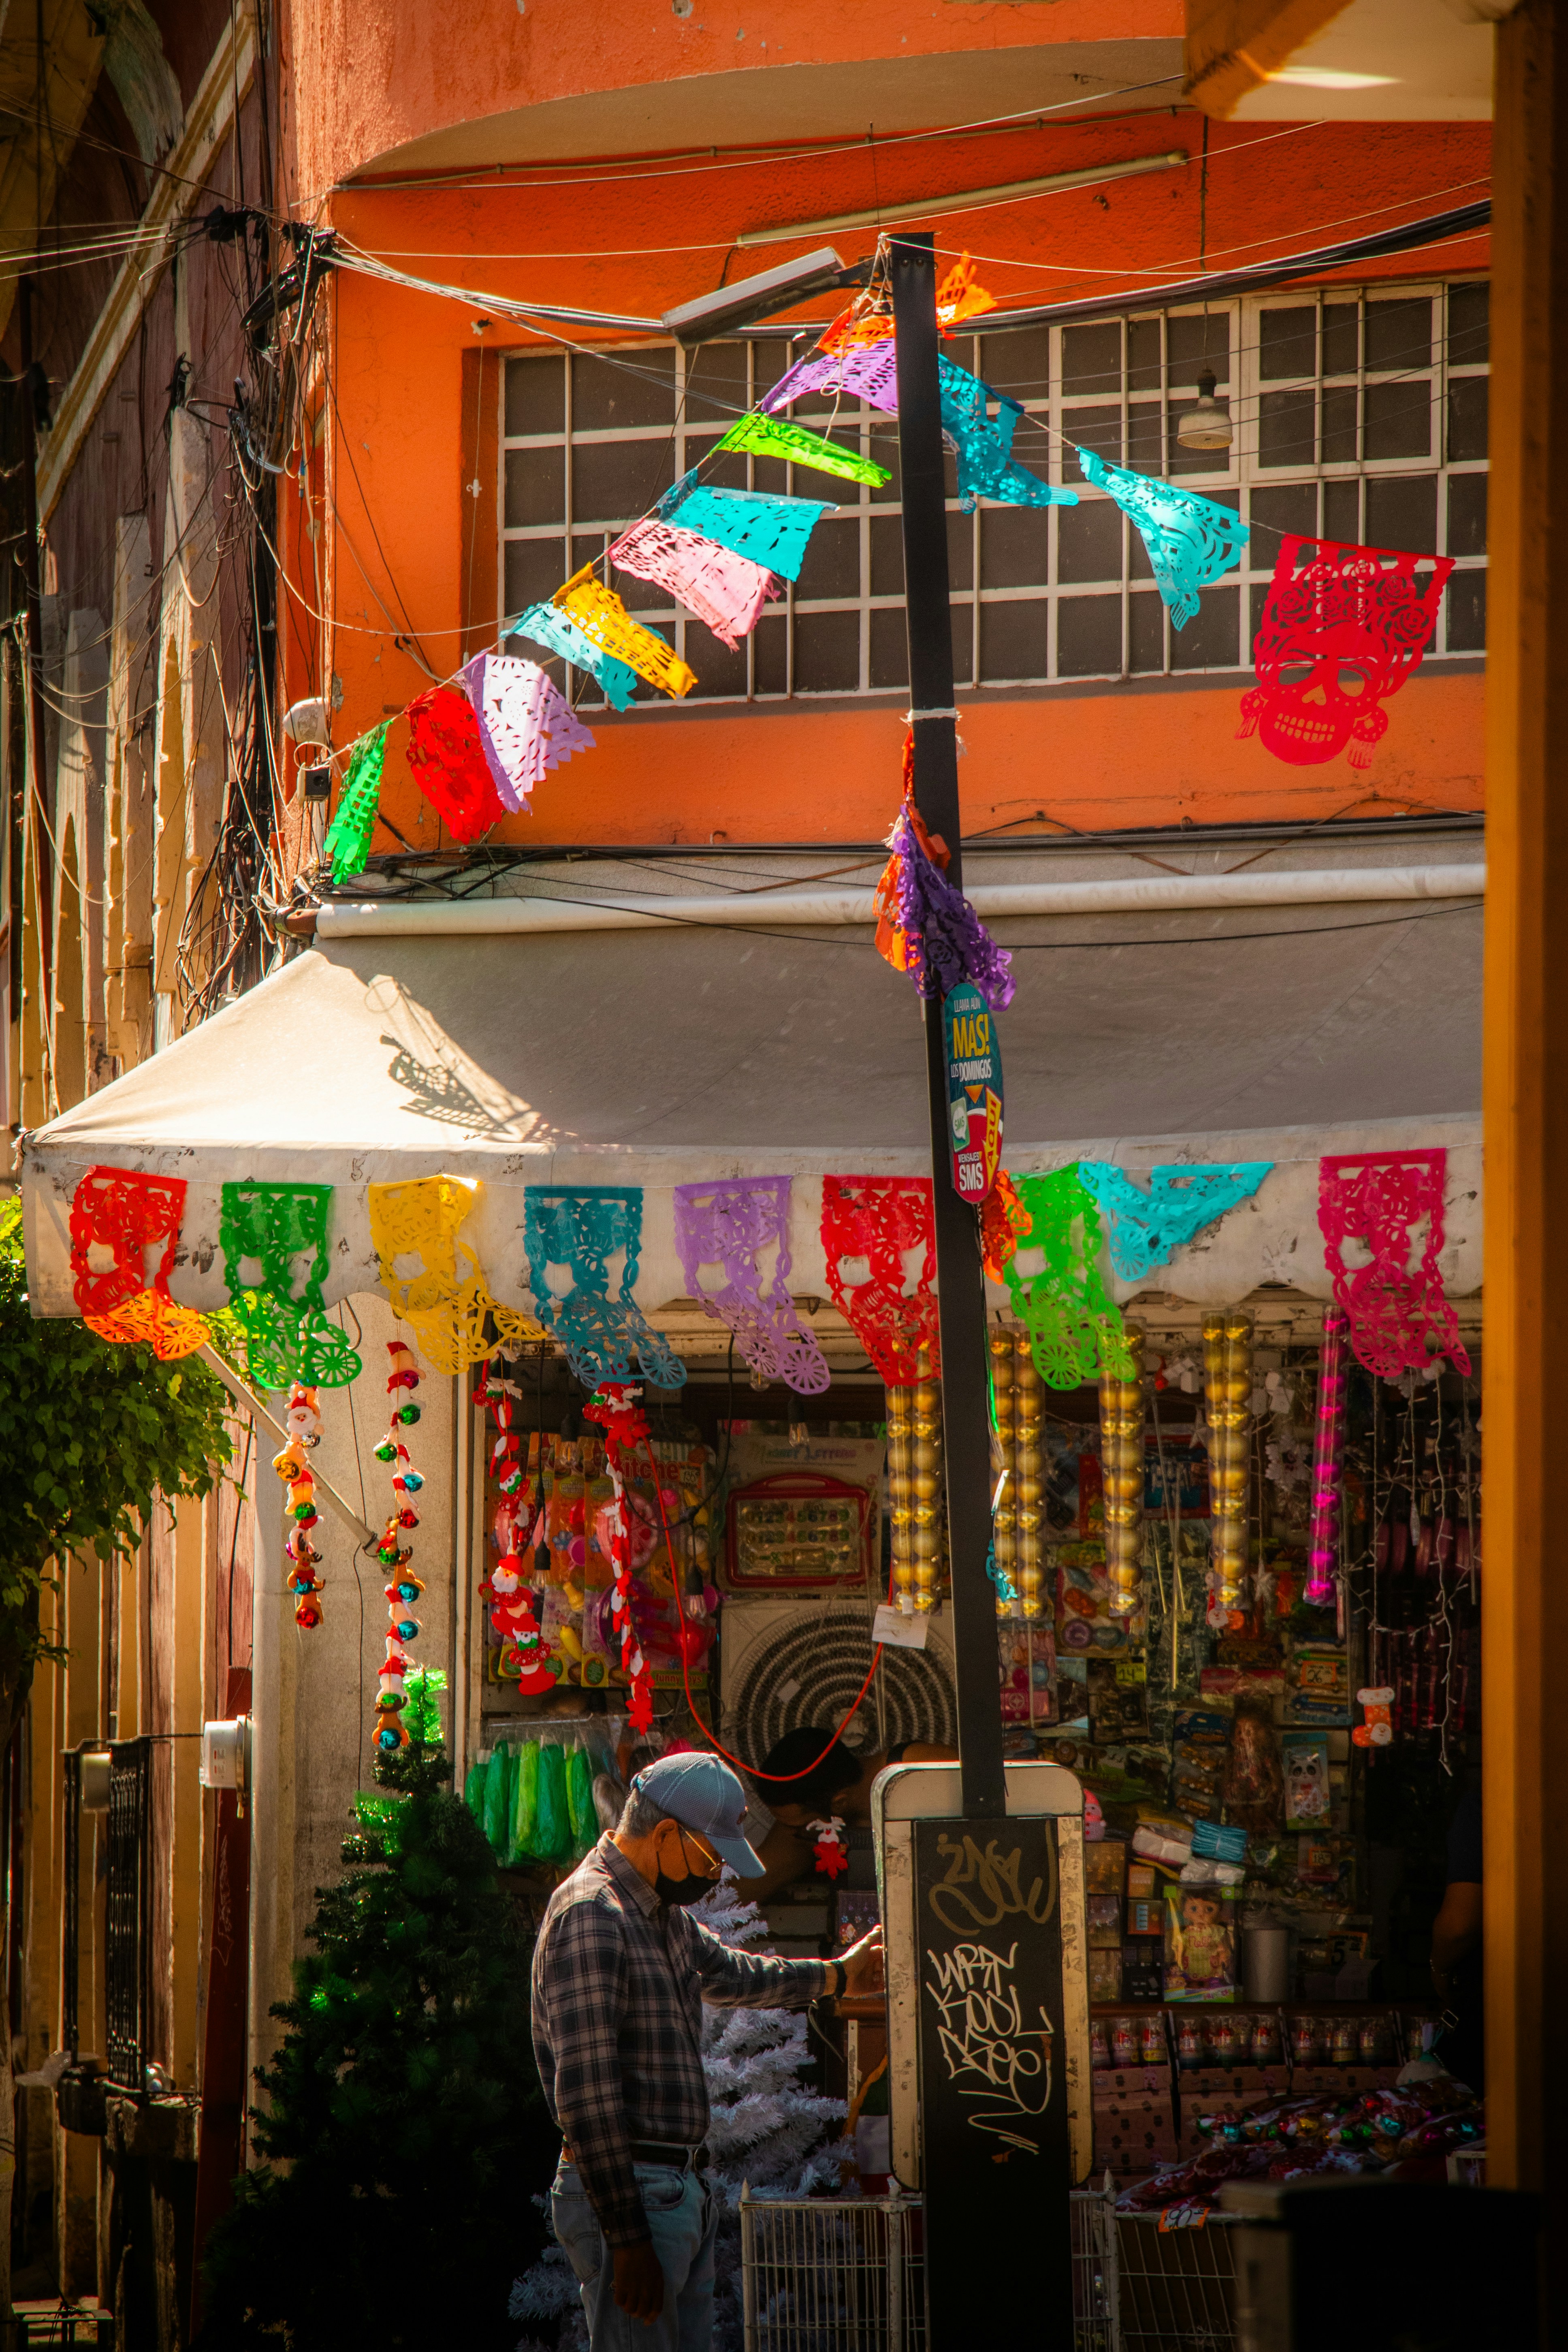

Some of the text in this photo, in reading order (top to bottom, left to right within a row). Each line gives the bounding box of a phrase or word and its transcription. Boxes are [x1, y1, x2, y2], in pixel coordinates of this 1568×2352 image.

[954, 994, 981, 1013] LLAMA AÚN
[953, 1013, 990, 1059] MÁS!
[950, 1058, 992, 1083] LOS DOMINGOS
[955, 1116, 964, 1131] SMS
[958, 1151, 979, 1163] MENSAJES
[959, 1162, 984, 1191] SMS
